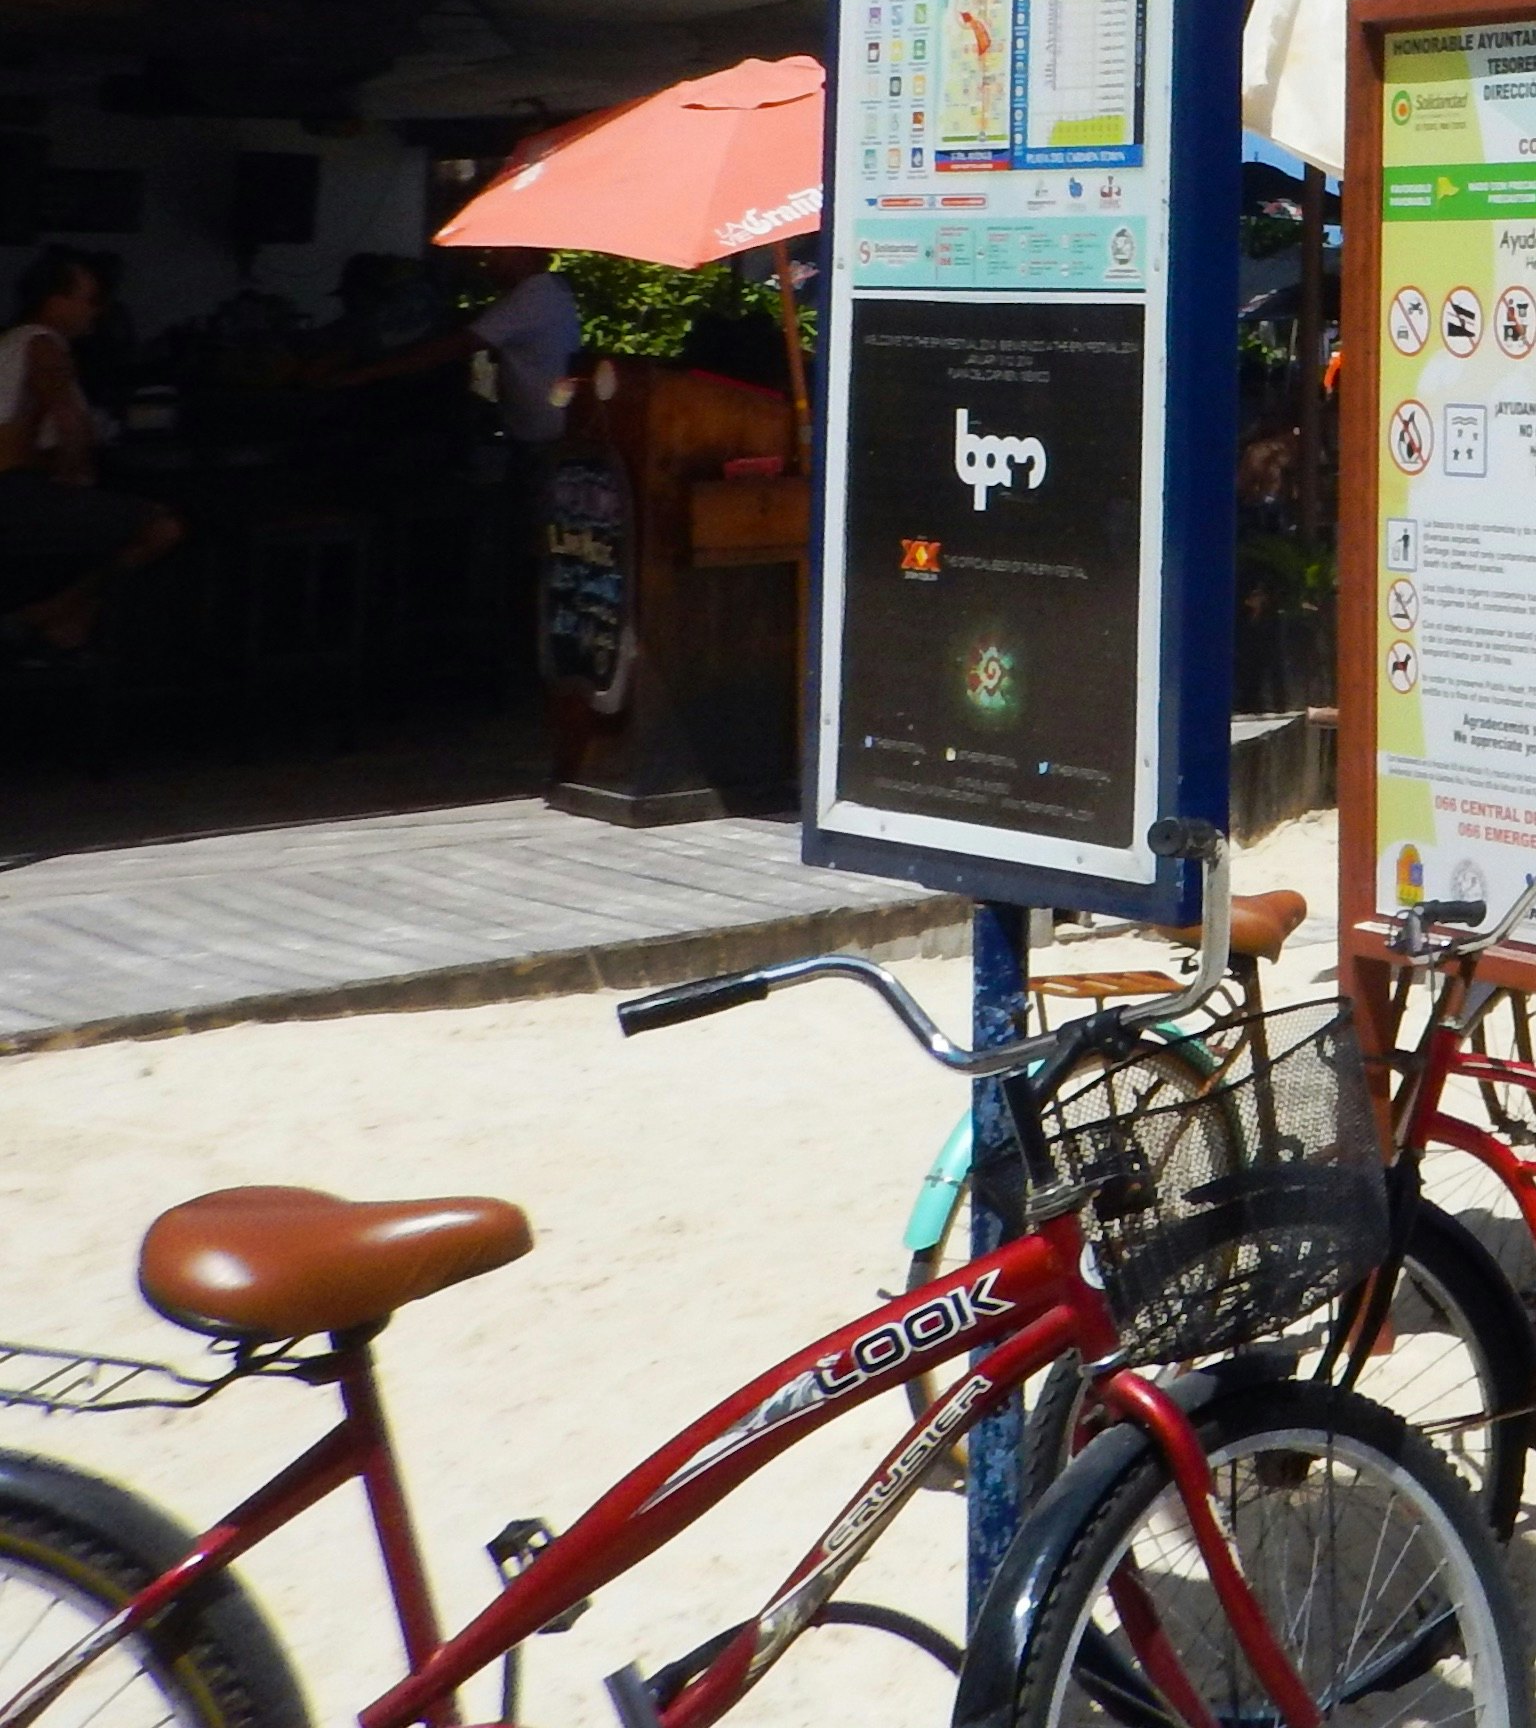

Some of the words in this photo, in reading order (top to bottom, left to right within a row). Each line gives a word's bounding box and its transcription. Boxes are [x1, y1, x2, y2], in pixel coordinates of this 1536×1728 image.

[1393, 34, 1474, 55] HONORABLE
[1519, 424, 1532, 438] NO
[955, 408, 1047, 512] bpm
[1463, 713, 1529, 735] Agradecemos
[1454, 730, 1467, 744] We
[1470, 735, 1522, 752] appreciate
[1460, 799, 1520, 823] CENTRAL
[814, 1269, 1017, 1400] LOOK
